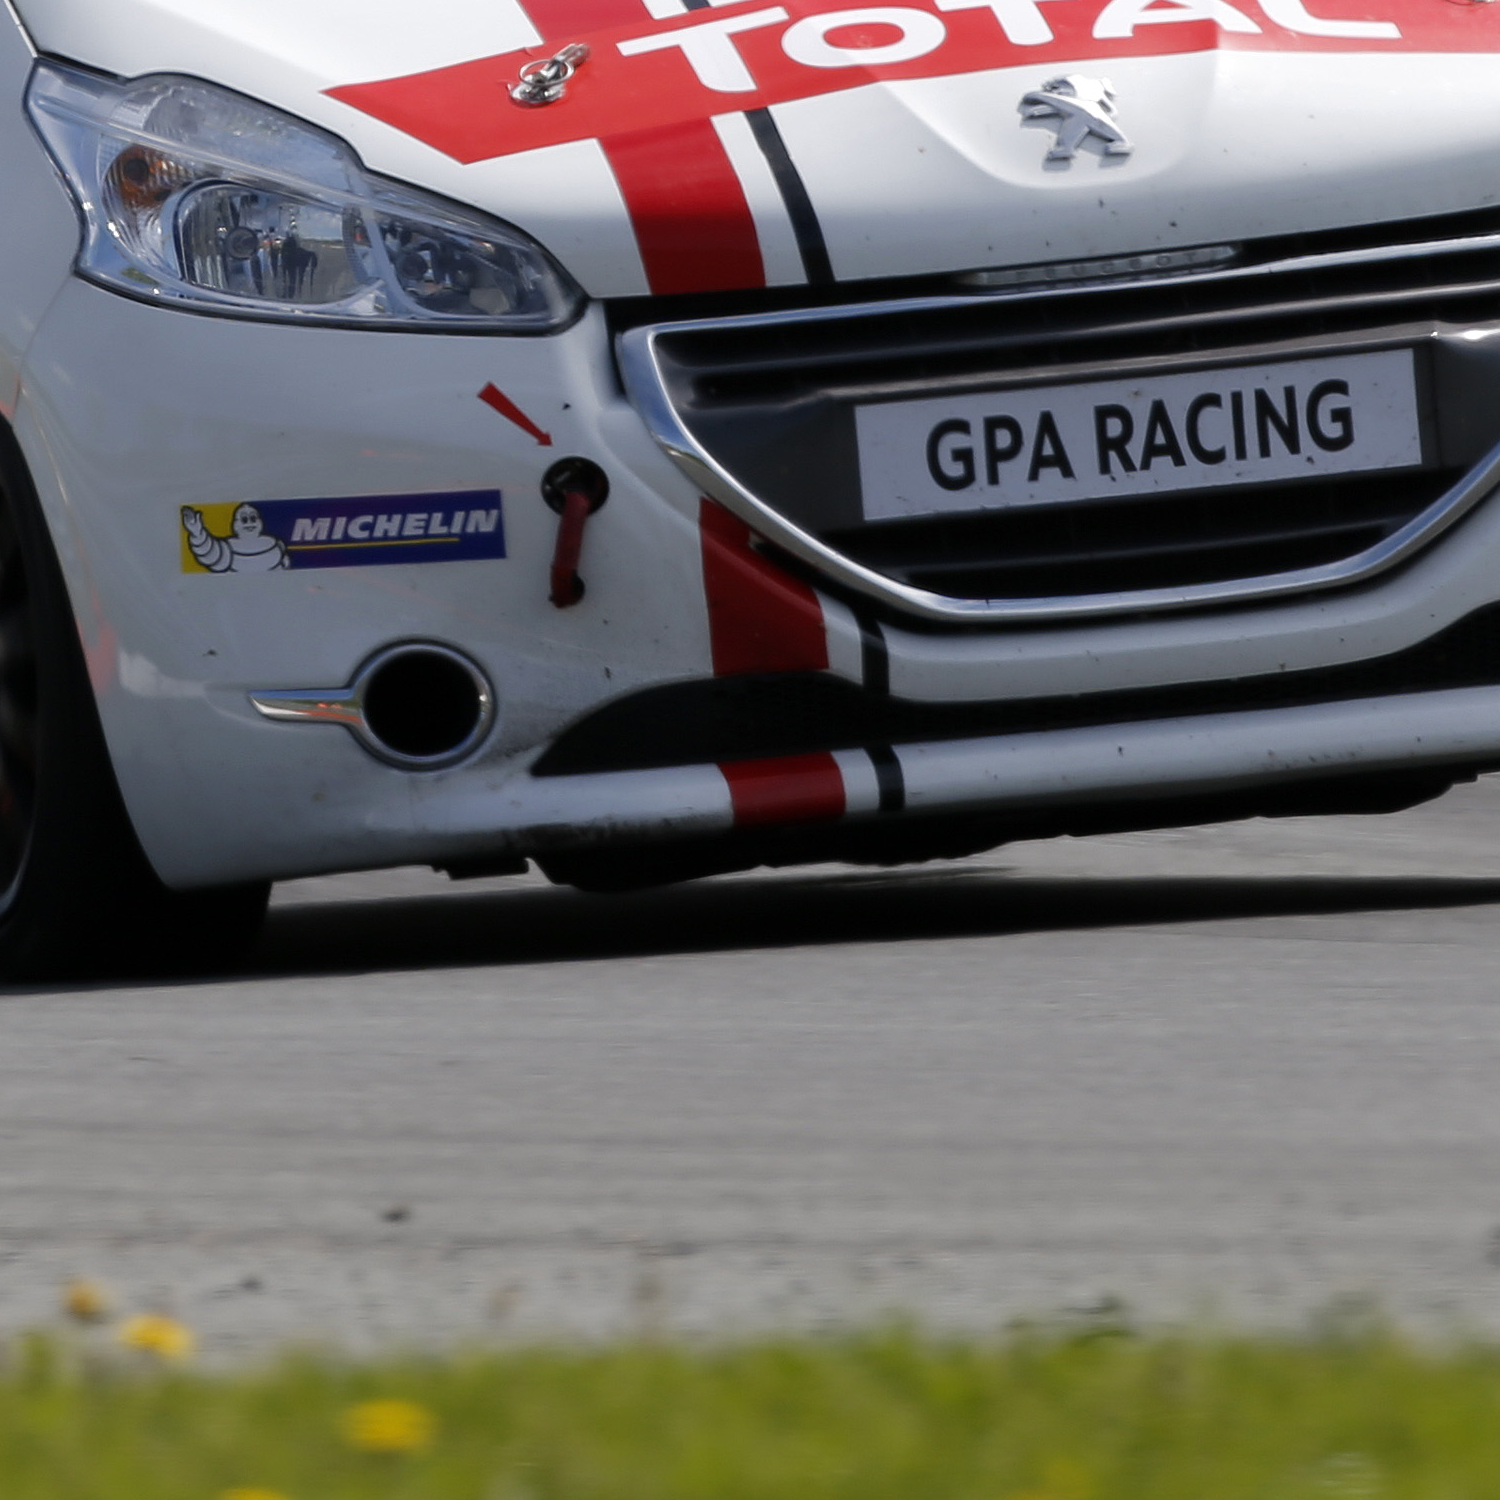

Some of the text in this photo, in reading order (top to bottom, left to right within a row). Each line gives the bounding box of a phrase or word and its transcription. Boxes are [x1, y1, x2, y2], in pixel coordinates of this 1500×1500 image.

[925, 379, 1355, 492] GPA RACING
[291, 509, 499, 543] MICHELIN
